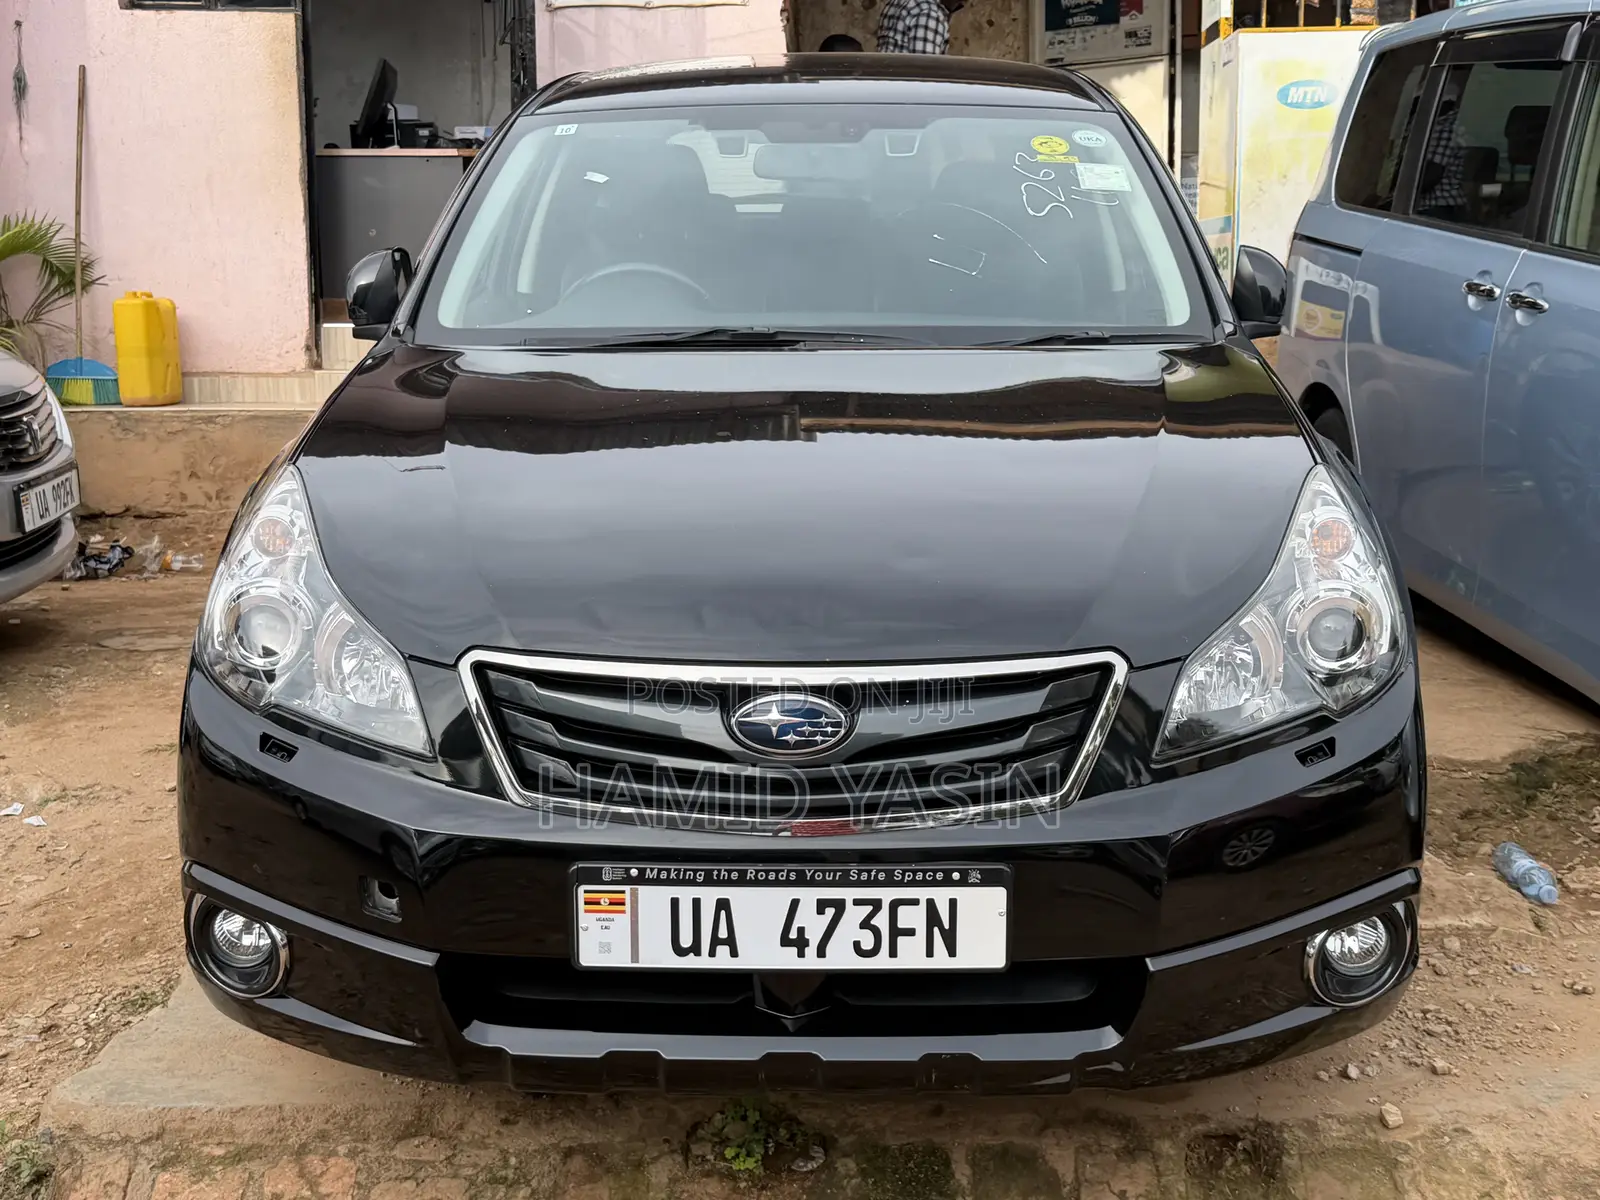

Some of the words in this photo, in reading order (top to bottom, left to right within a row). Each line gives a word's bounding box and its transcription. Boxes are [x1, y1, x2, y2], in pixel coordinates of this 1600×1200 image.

[1287, 86, 1328, 104] MTN
[35, 488, 51, 520] UA
[645, 867, 706, 882] Making
[712, 868, 739, 880] the
[746, 869, 797, 880] Roads
[804, 869, 843, 881] Your
[849, 869, 886, 881] Safe
[893, 869, 945, 883] Space
[669, 896, 740, 958] UA
[779, 897, 959, 959] 473FN
